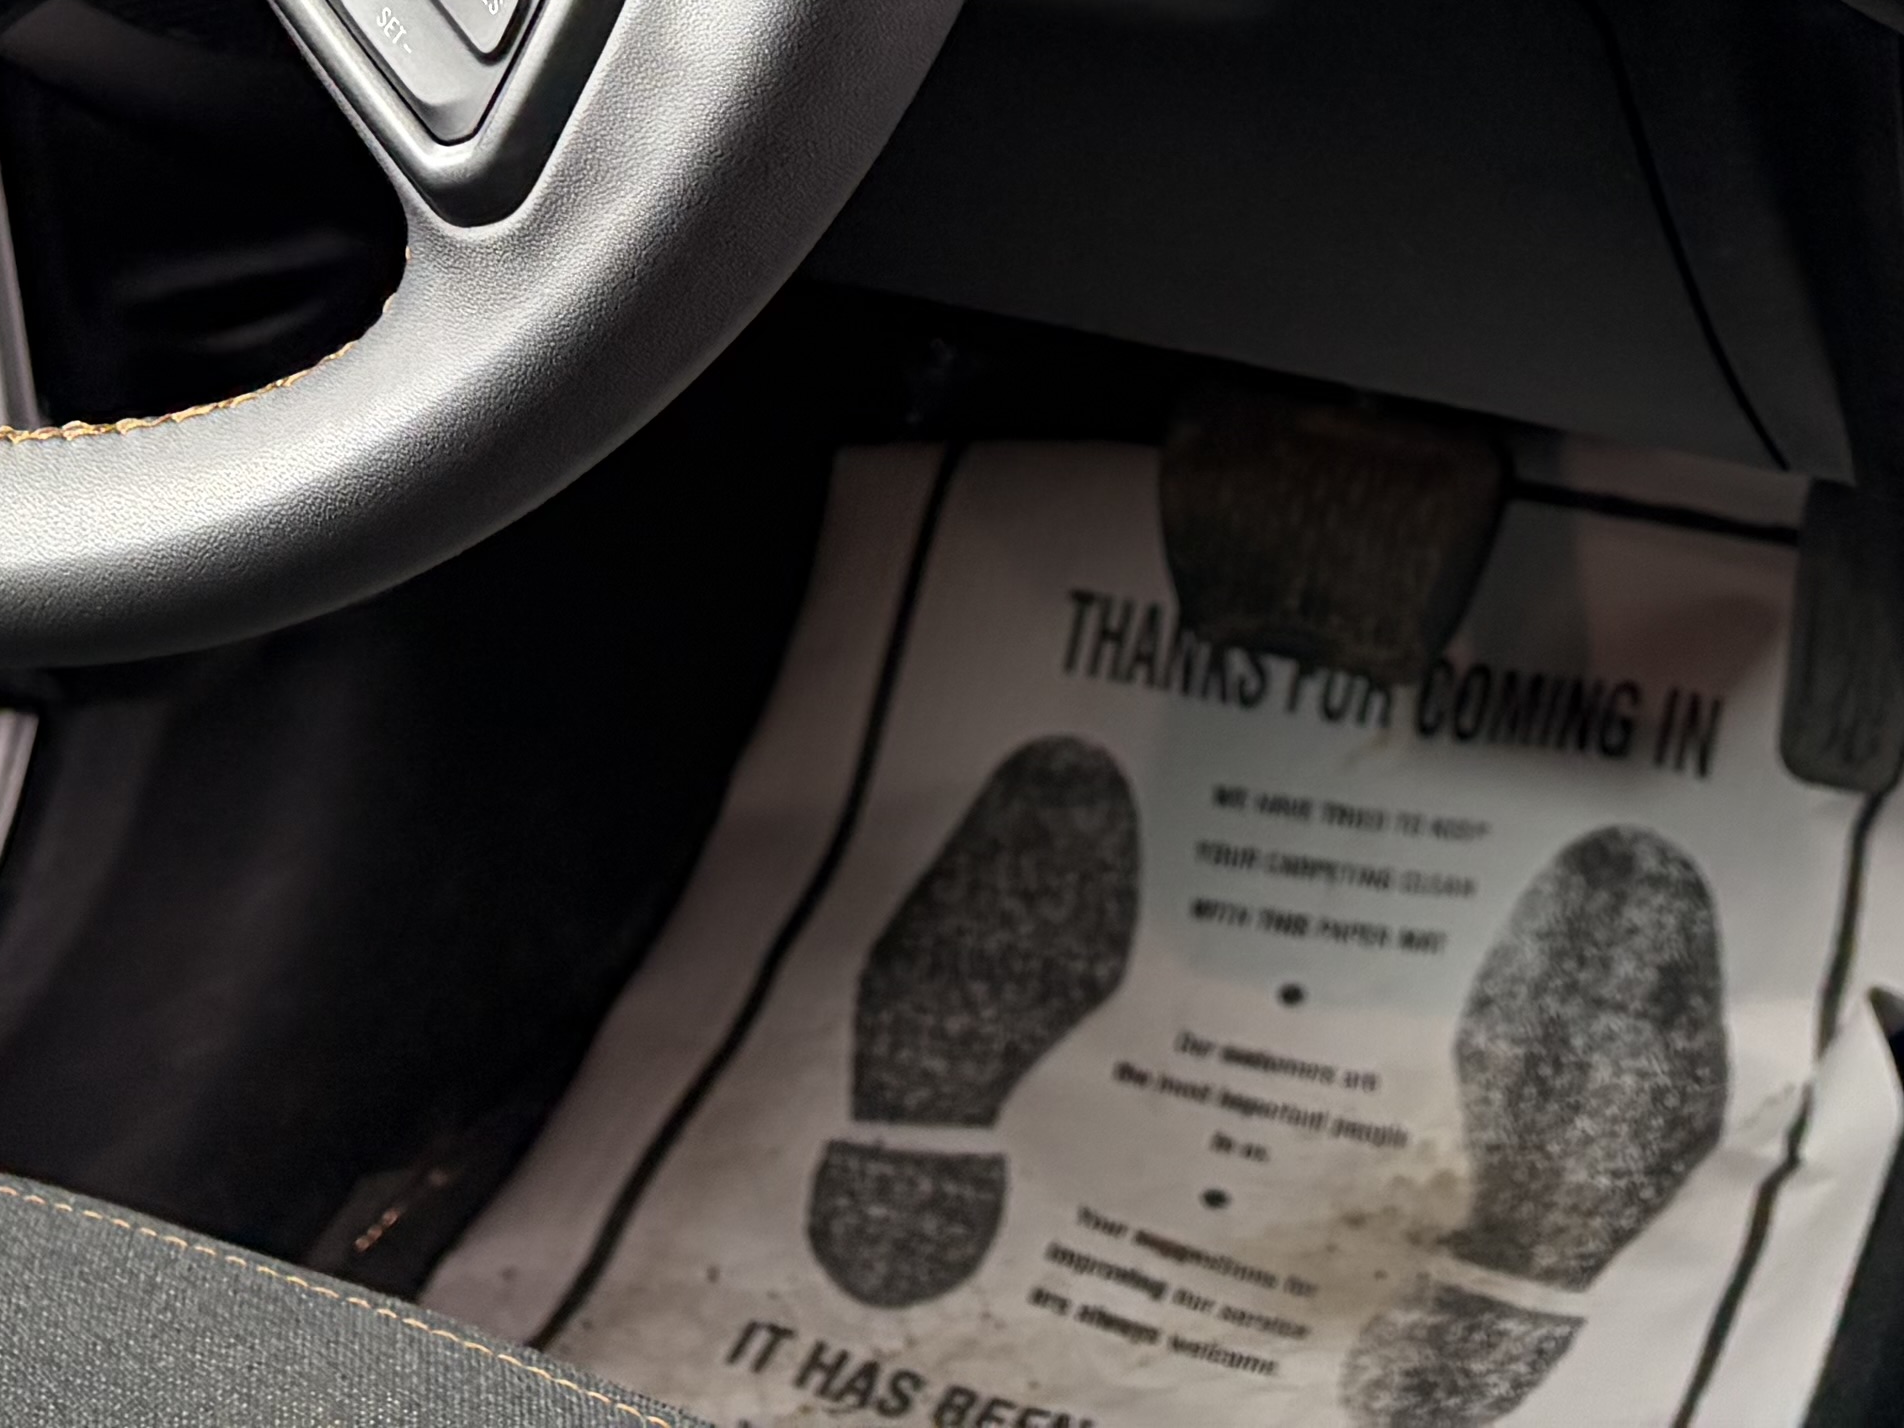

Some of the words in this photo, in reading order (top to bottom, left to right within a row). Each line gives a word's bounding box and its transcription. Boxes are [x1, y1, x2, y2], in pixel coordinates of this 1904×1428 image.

[1061, 587, 1269, 712] THANKS
[1414, 656, 1642, 761] COMING
[1653, 684, 1726, 780] IN
[726, 1320, 794, 1374] IT
[794, 1340, 926, 1419] HAS
